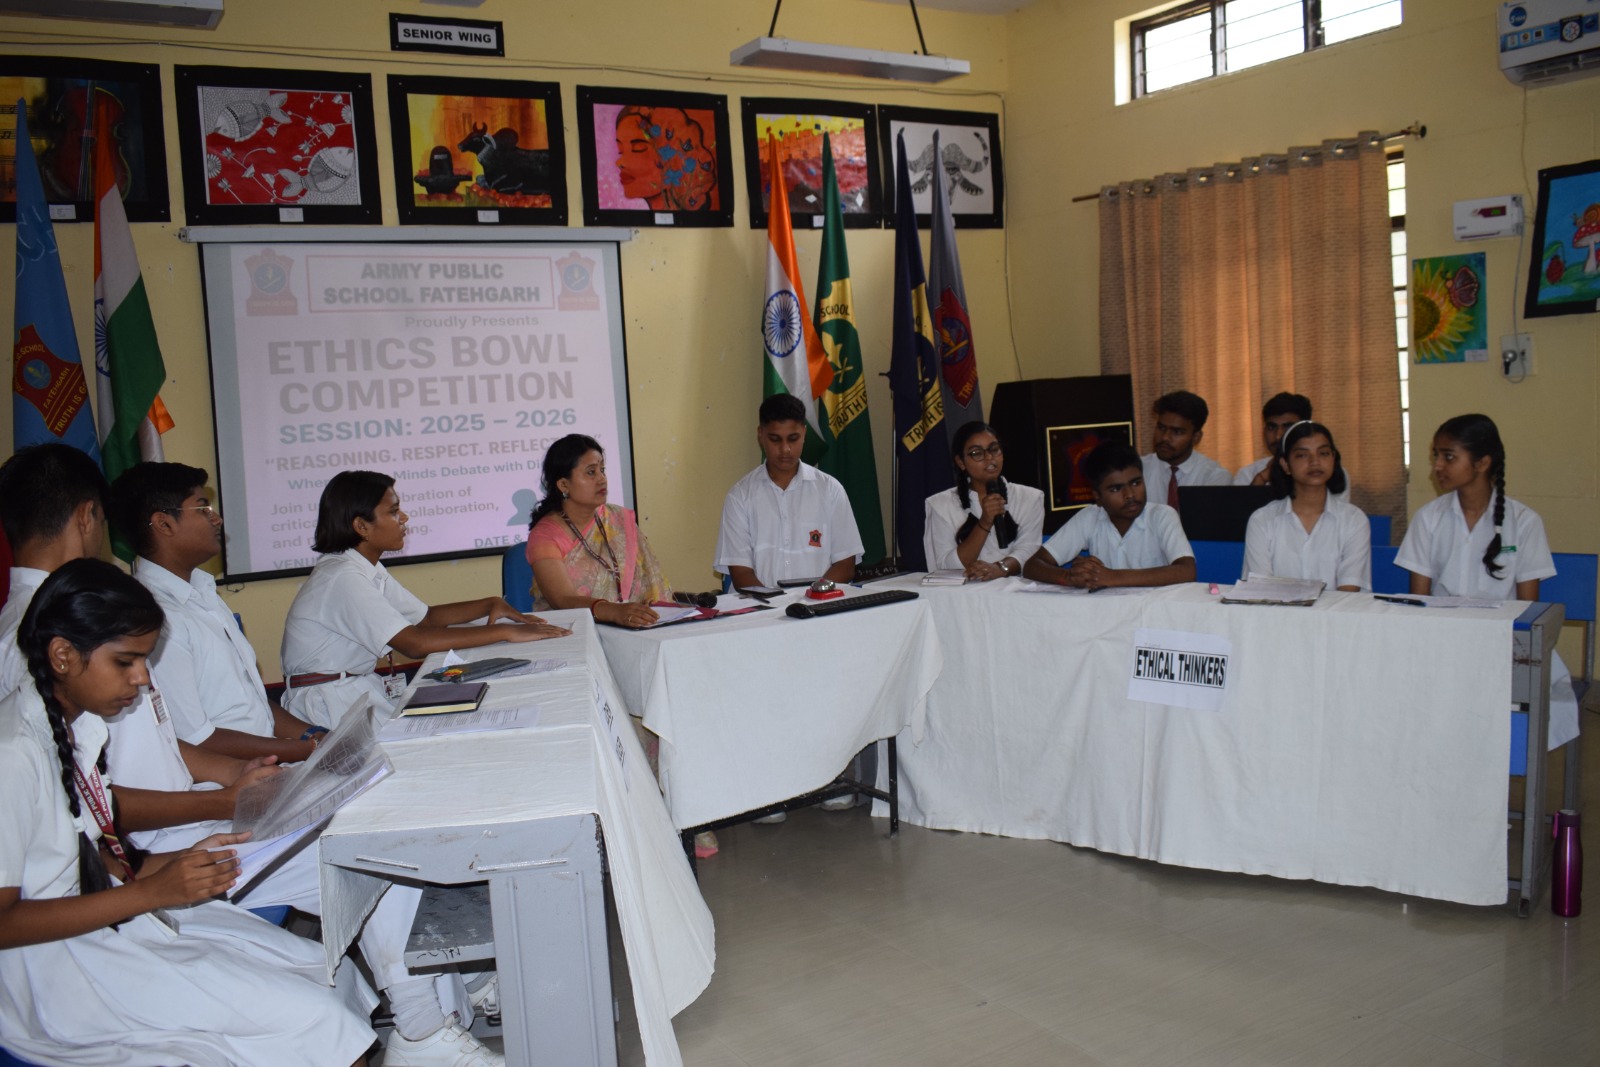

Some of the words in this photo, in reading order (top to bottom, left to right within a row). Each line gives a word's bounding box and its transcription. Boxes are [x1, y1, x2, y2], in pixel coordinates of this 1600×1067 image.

[403, 28, 453, 41] SENIOR
[458, 31, 492, 43] WING
[360, 262, 423, 280] ARMY
[429, 262, 504, 280] PUBLIC
[323, 286, 414, 305] SCHOOL
[419, 286, 541, 303] FATEHGARH
[405, 315, 467, 330] Proudly
[472, 315, 539, 328] Presents
[267, 336, 437, 375] ETHICS
[451, 333, 579, 368] BOWL
[279, 370, 574, 415] COMPETITION
[54, 405, 76, 432] TRUTH
[279, 418, 413, 445] SESSION:
[420, 413, 486, 435] 2025
[515, 408, 577, 429] 2026
[402, 442, 484, 462] RESPECT.
[393, 467, 437, 481] Minds
[441, 465, 490, 477] Debate
[494, 461, 523, 473] with
[271, 502, 303, 515] Join
[458, 486, 472, 497] of
[272, 535, 302, 549] and
[474, 535, 510, 548] DATE
[513, 534, 523, 544] &
[1136, 649, 1175, 680] ETHICAL
[1178, 653, 1226, 686] THINKERS
[83, 788, 98, 811] PUBLIC
[95, 810, 108, 827] ARMY
